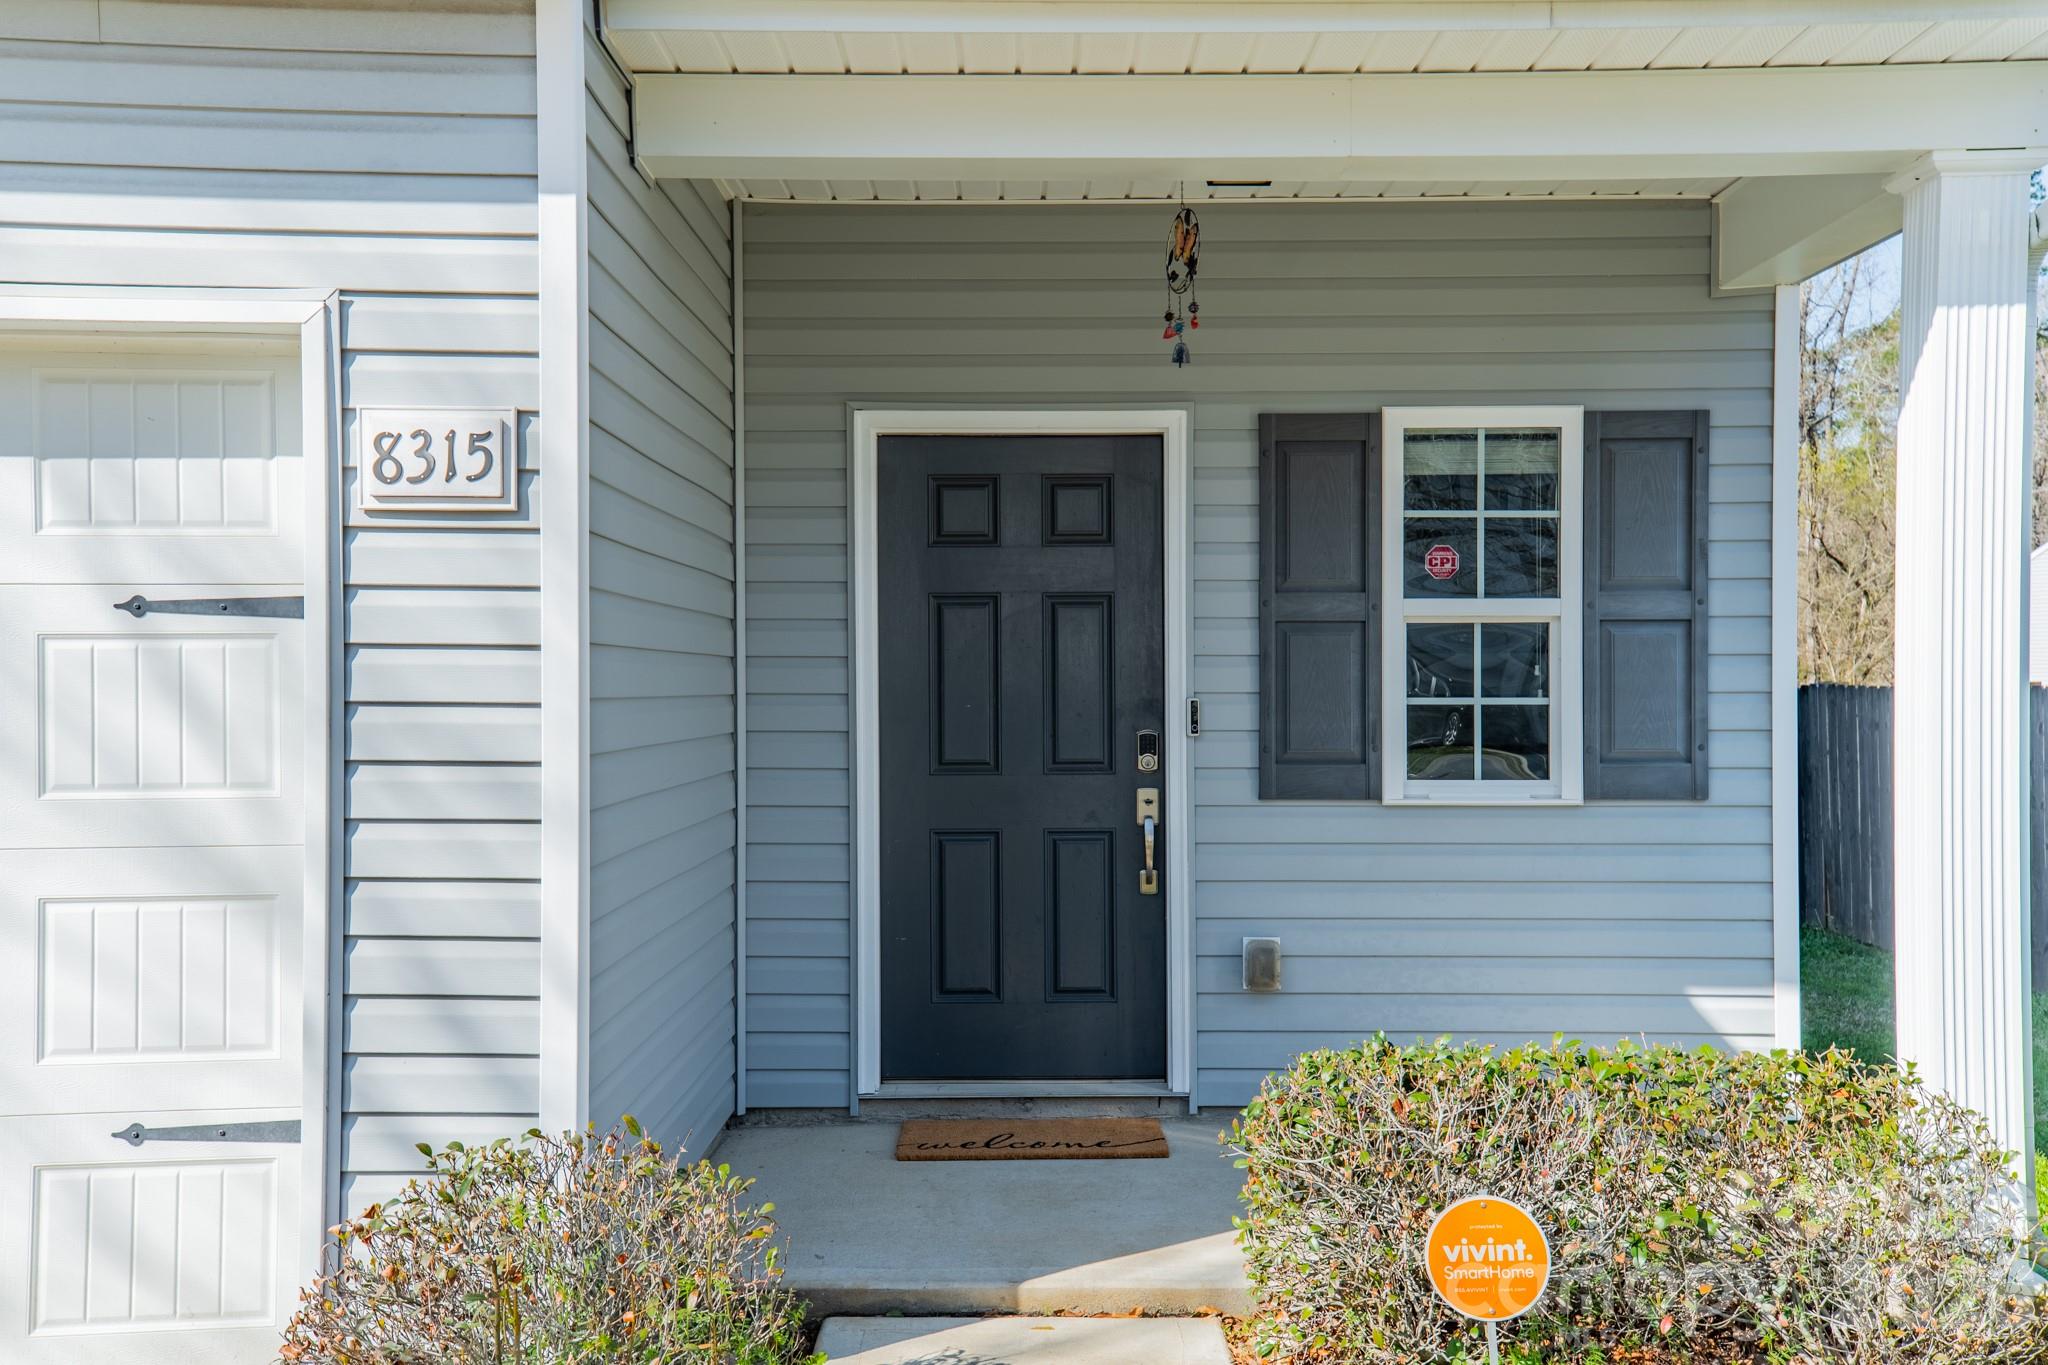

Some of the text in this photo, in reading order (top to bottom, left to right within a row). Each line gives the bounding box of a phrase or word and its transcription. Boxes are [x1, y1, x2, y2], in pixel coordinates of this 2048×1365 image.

[372, 429, 493, 485] 8315
[1428, 556, 1456, 568] CPI
[914, 1133, 1165, 1150] welcome
[1442, 1236, 1533, 1262] vivint.
[1443, 1265, 1534, 1280] SmartHome
